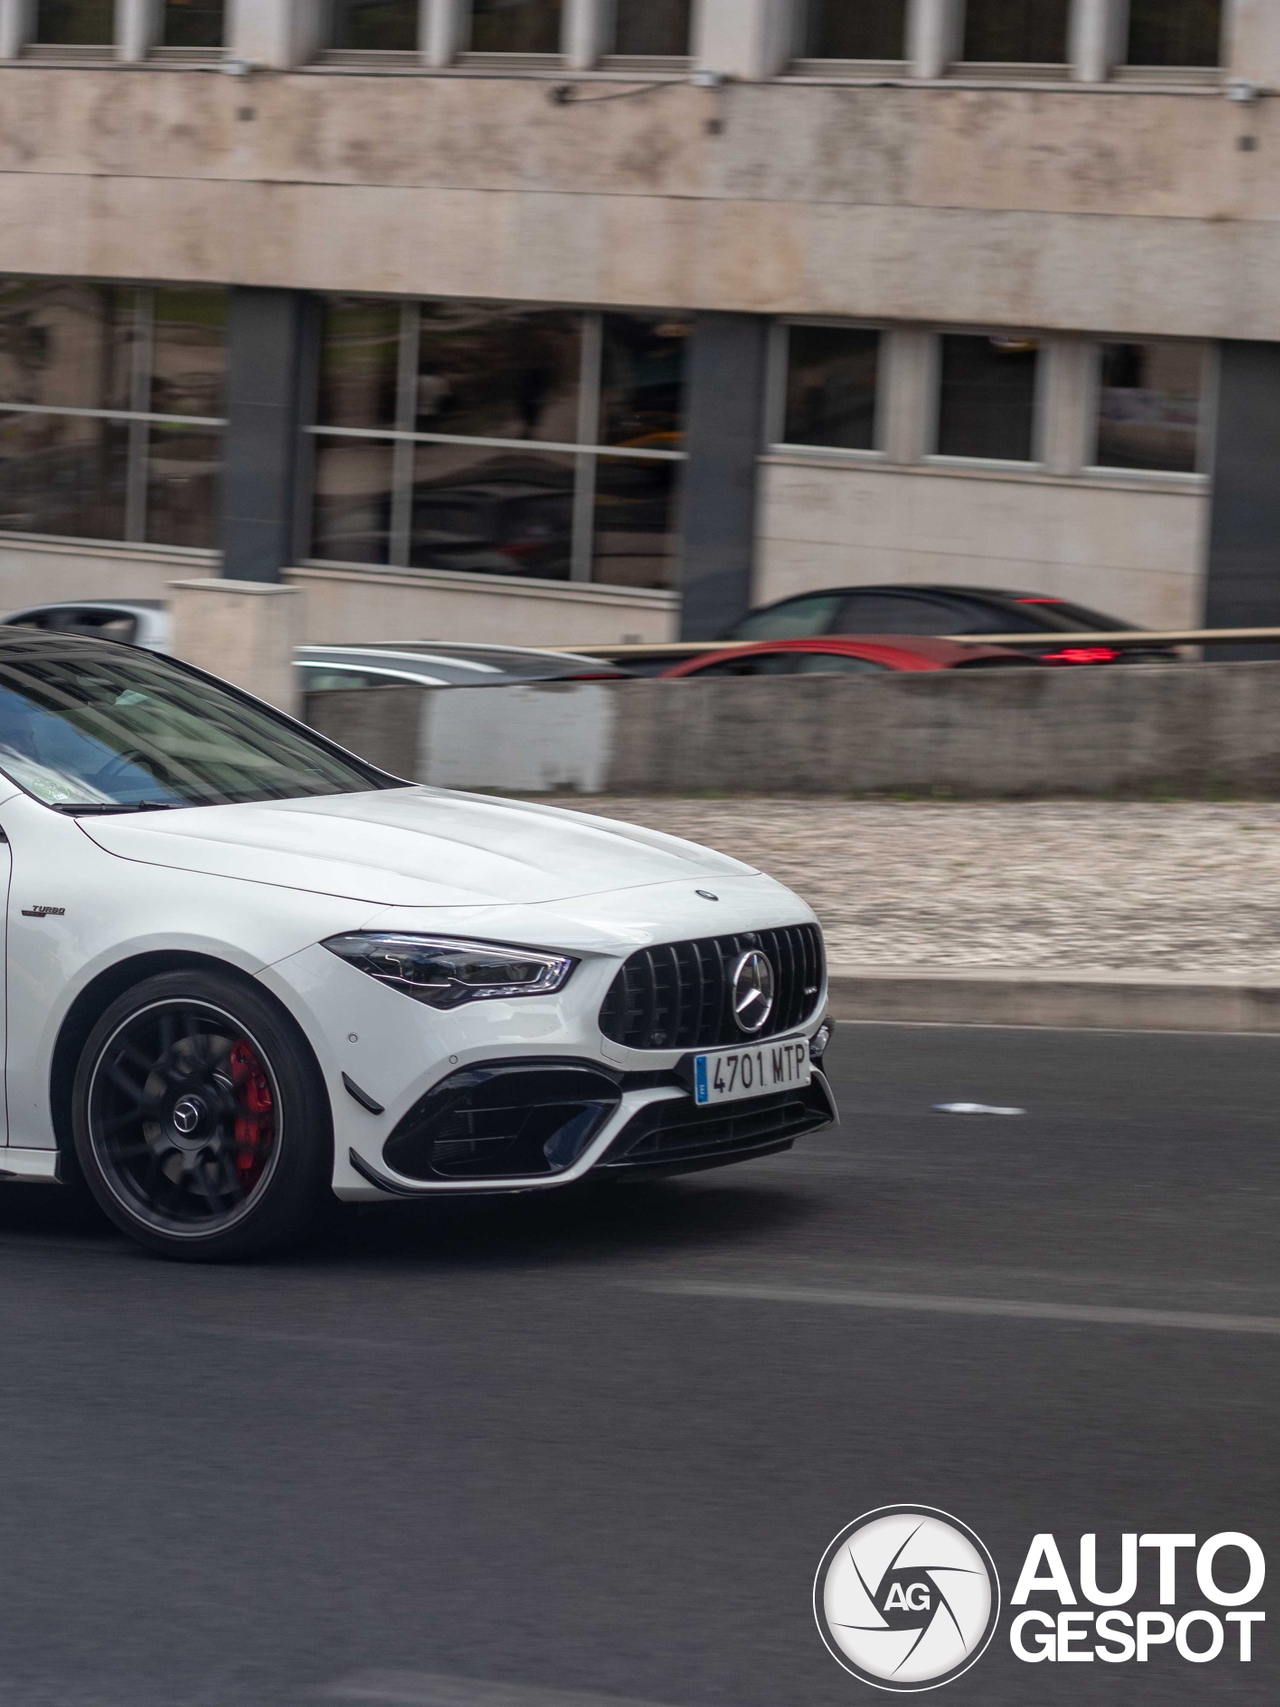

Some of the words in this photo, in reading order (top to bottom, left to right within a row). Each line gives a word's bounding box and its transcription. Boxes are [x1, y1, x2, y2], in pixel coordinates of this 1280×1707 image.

[32, 905, 66, 915] TURBO
[713, 1051, 765, 1094] 4701
[772, 1044, 806, 1084] MTP
